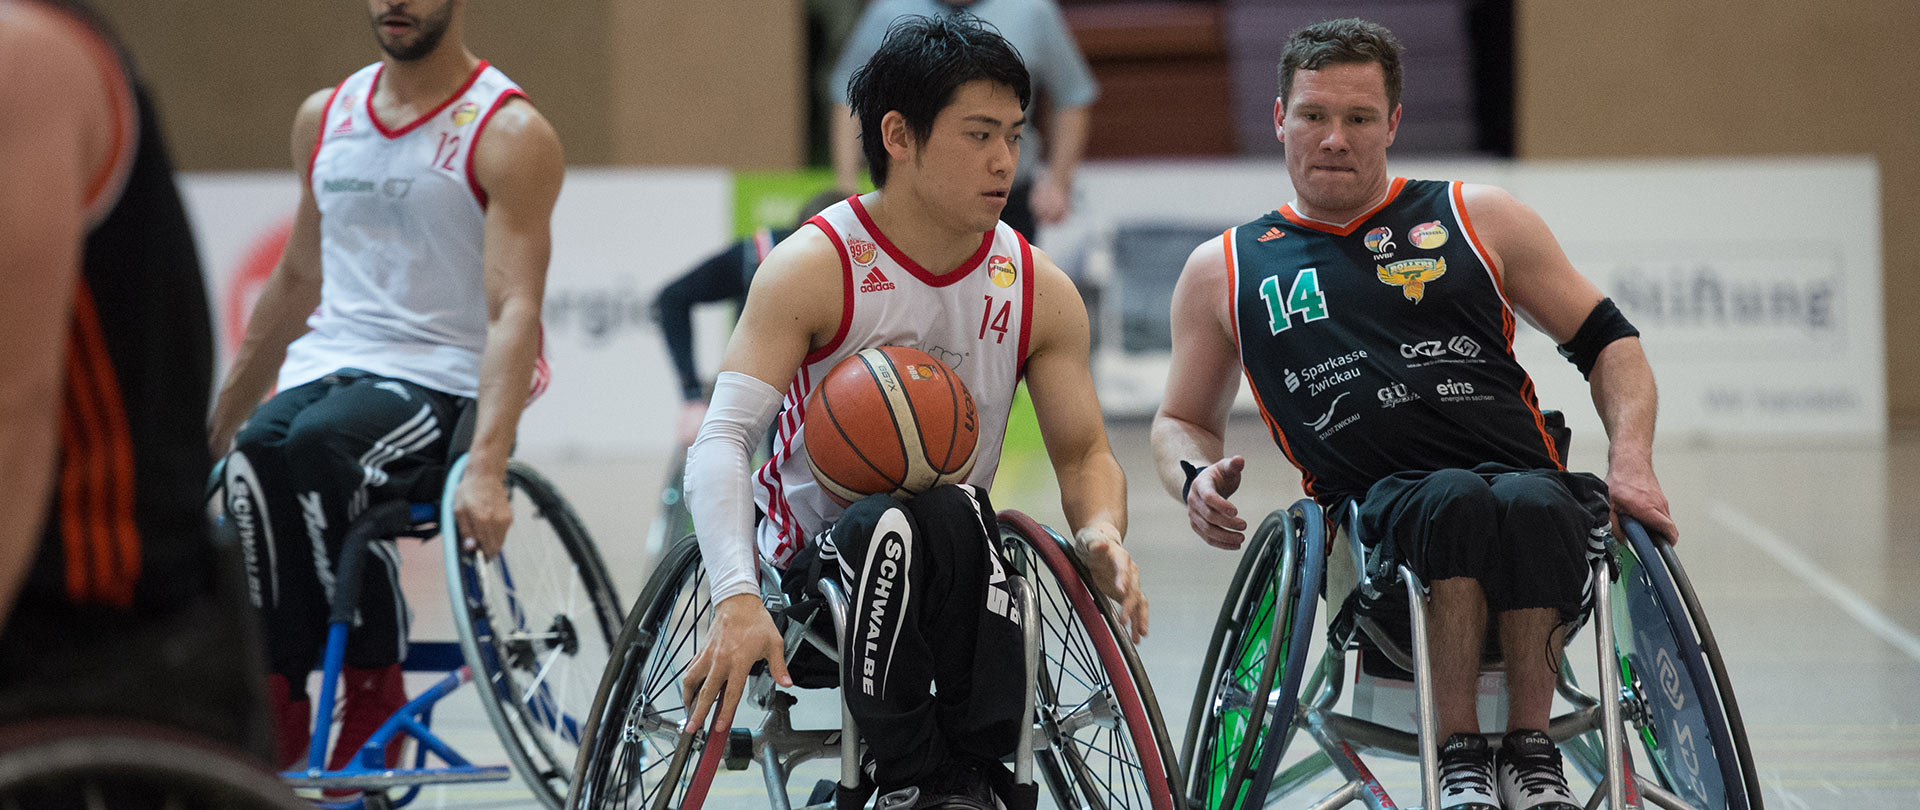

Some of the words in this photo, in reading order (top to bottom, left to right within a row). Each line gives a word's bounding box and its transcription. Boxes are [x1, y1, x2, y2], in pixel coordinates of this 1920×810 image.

[431, 131, 460, 171] 12
[1373, 252, 1394, 261] IWBF
[860, 282, 896, 293] adidas
[1259, 267, 1330, 337] 14
[978, 294, 1011, 345] 14
[1301, 350, 1368, 381] Sparkasse
[1308, 368, 1361, 397] Zwickau
[1436, 378, 1474, 395] eins
[1319, 428, 1335, 441] STADT
[1335, 413, 1361, 432] ZWICKAU
[862, 538, 902, 697] SCHWALBE
